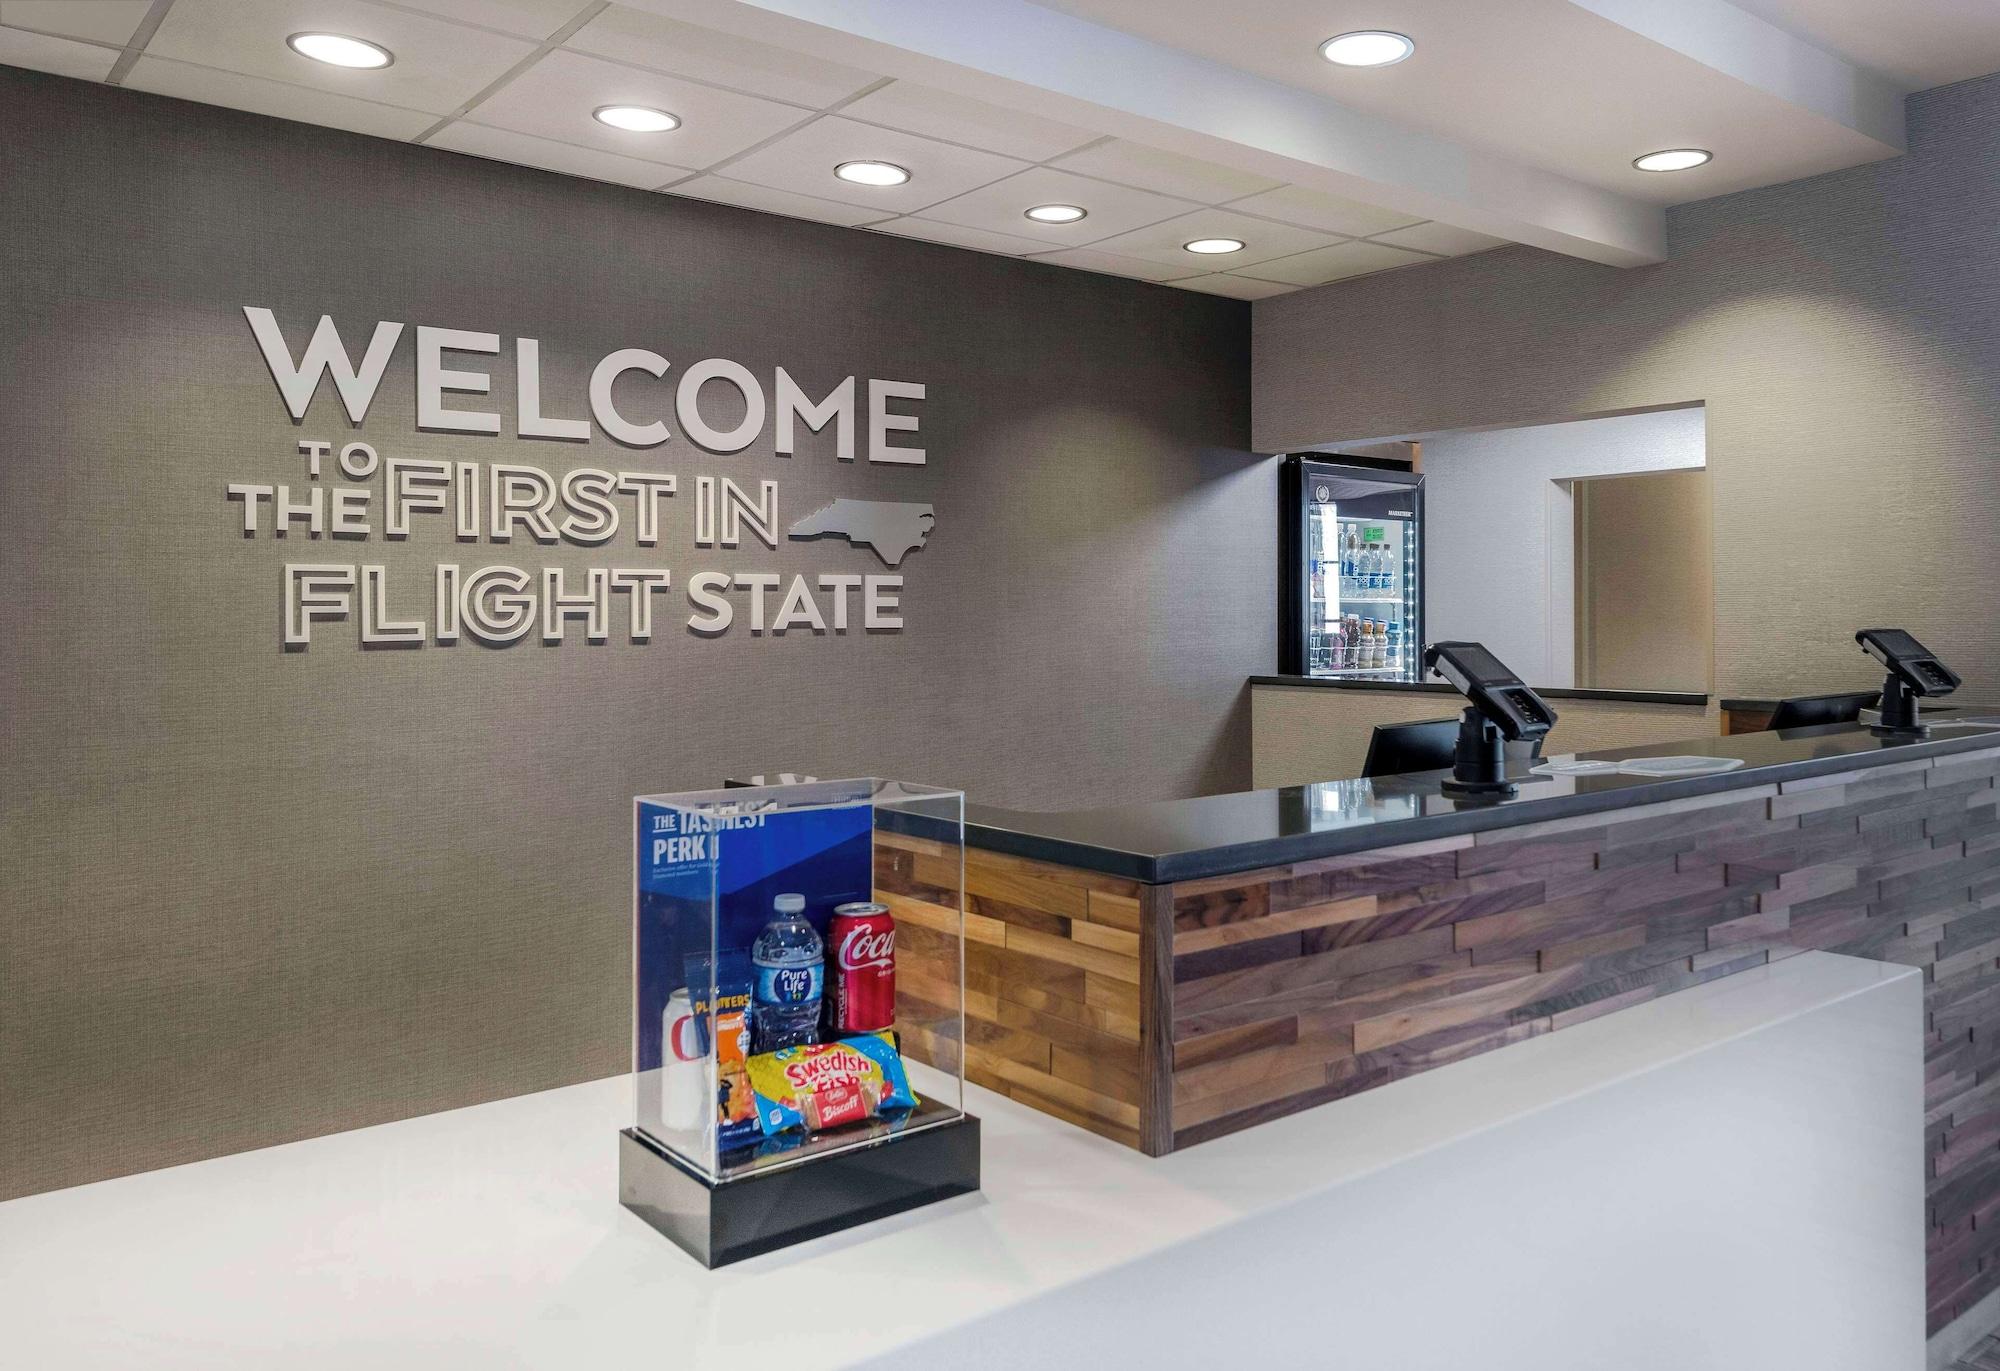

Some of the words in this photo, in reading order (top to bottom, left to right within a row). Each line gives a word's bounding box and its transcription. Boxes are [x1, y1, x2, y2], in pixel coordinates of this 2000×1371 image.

[243, 306, 926, 465] WELCOME
[299, 440, 378, 479] TO
[228, 484, 371, 535] THE
[386, 457, 677, 546] FIRST
[695, 476, 779, 546] IN
[284, 564, 671, 643] FLIGHT
[687, 572, 905, 636] STATE
[652, 814, 676, 830] THE
[677, 810, 766, 834] TASIEST
[653, 835, 706, 865] PERK
[838, 923, 895, 971] Coca
[781, 969, 808, 981] Pure
[783, 980, 805, 993] Life
[695, 994, 750, 1015] PLNTERS
[785, 1052, 871, 1089] Swedish
[810, 1072, 861, 1094] Fish
[822, 1094, 859, 1122] Biscoff
